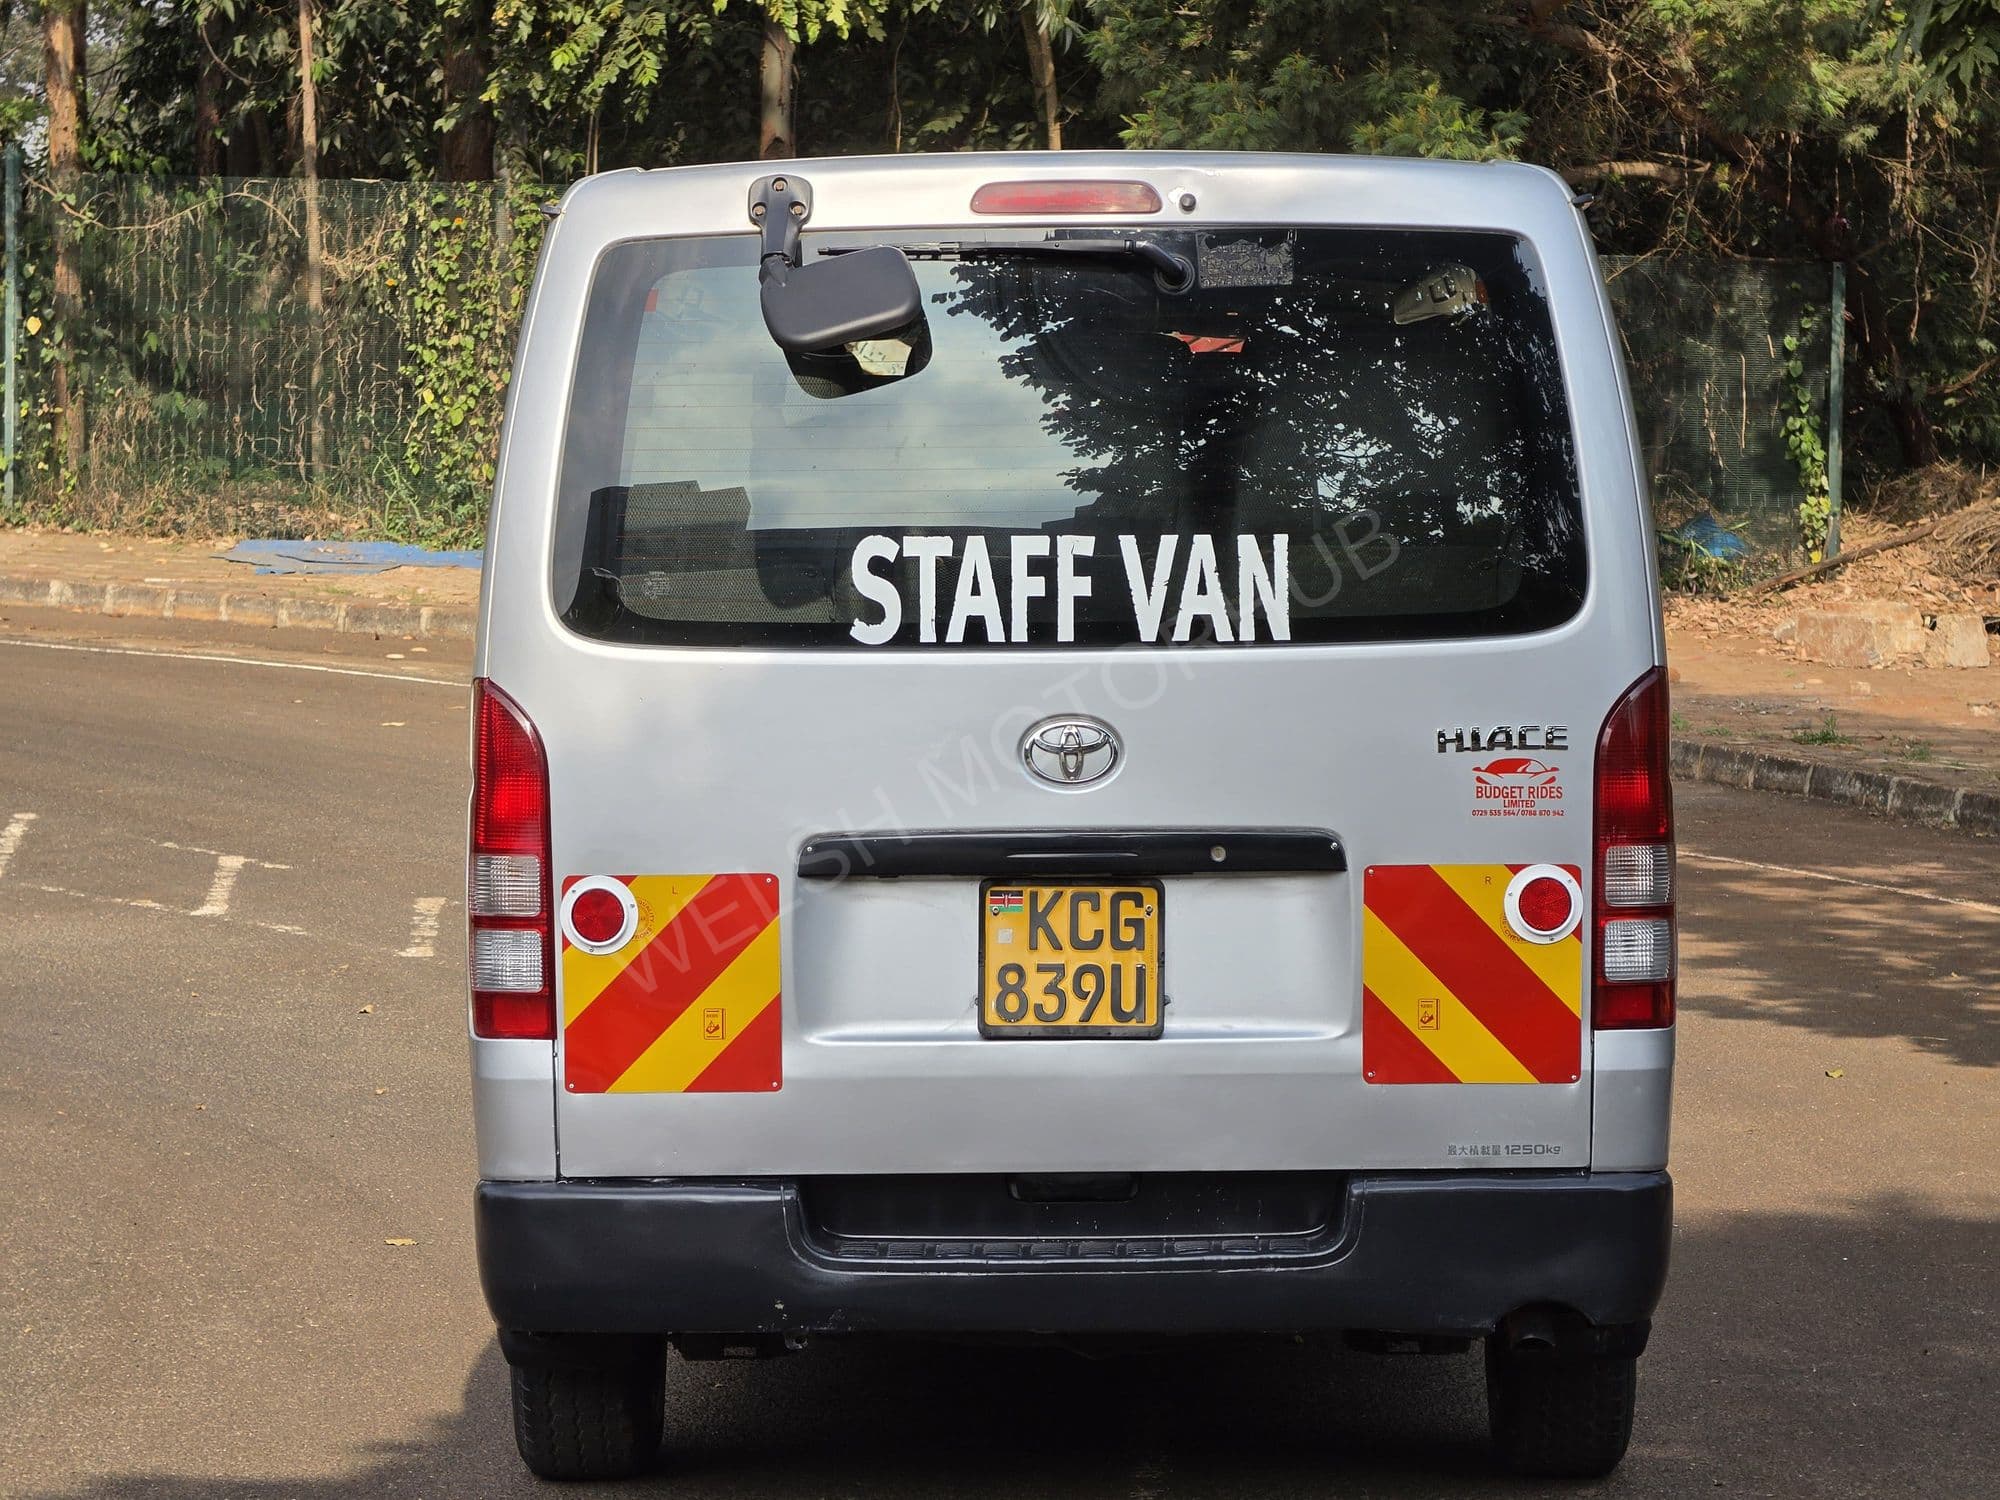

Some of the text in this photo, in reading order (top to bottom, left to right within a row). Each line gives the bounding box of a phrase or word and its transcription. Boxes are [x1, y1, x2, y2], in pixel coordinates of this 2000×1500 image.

[850, 534, 1291, 644] STAFF VAN
[1437, 725, 1568, 753] HIACE
[1476, 786, 1563, 799] BUDGET RIDES
[1503, 800, 1536, 808] LIMITED
[1485, 876, 1492, 885] R
[672, 886, 679, 895] L
[1029, 891, 1146, 951] KCG
[996, 963, 1146, 1023] 839U
[1504, 1144, 1561, 1155] 1250kg
